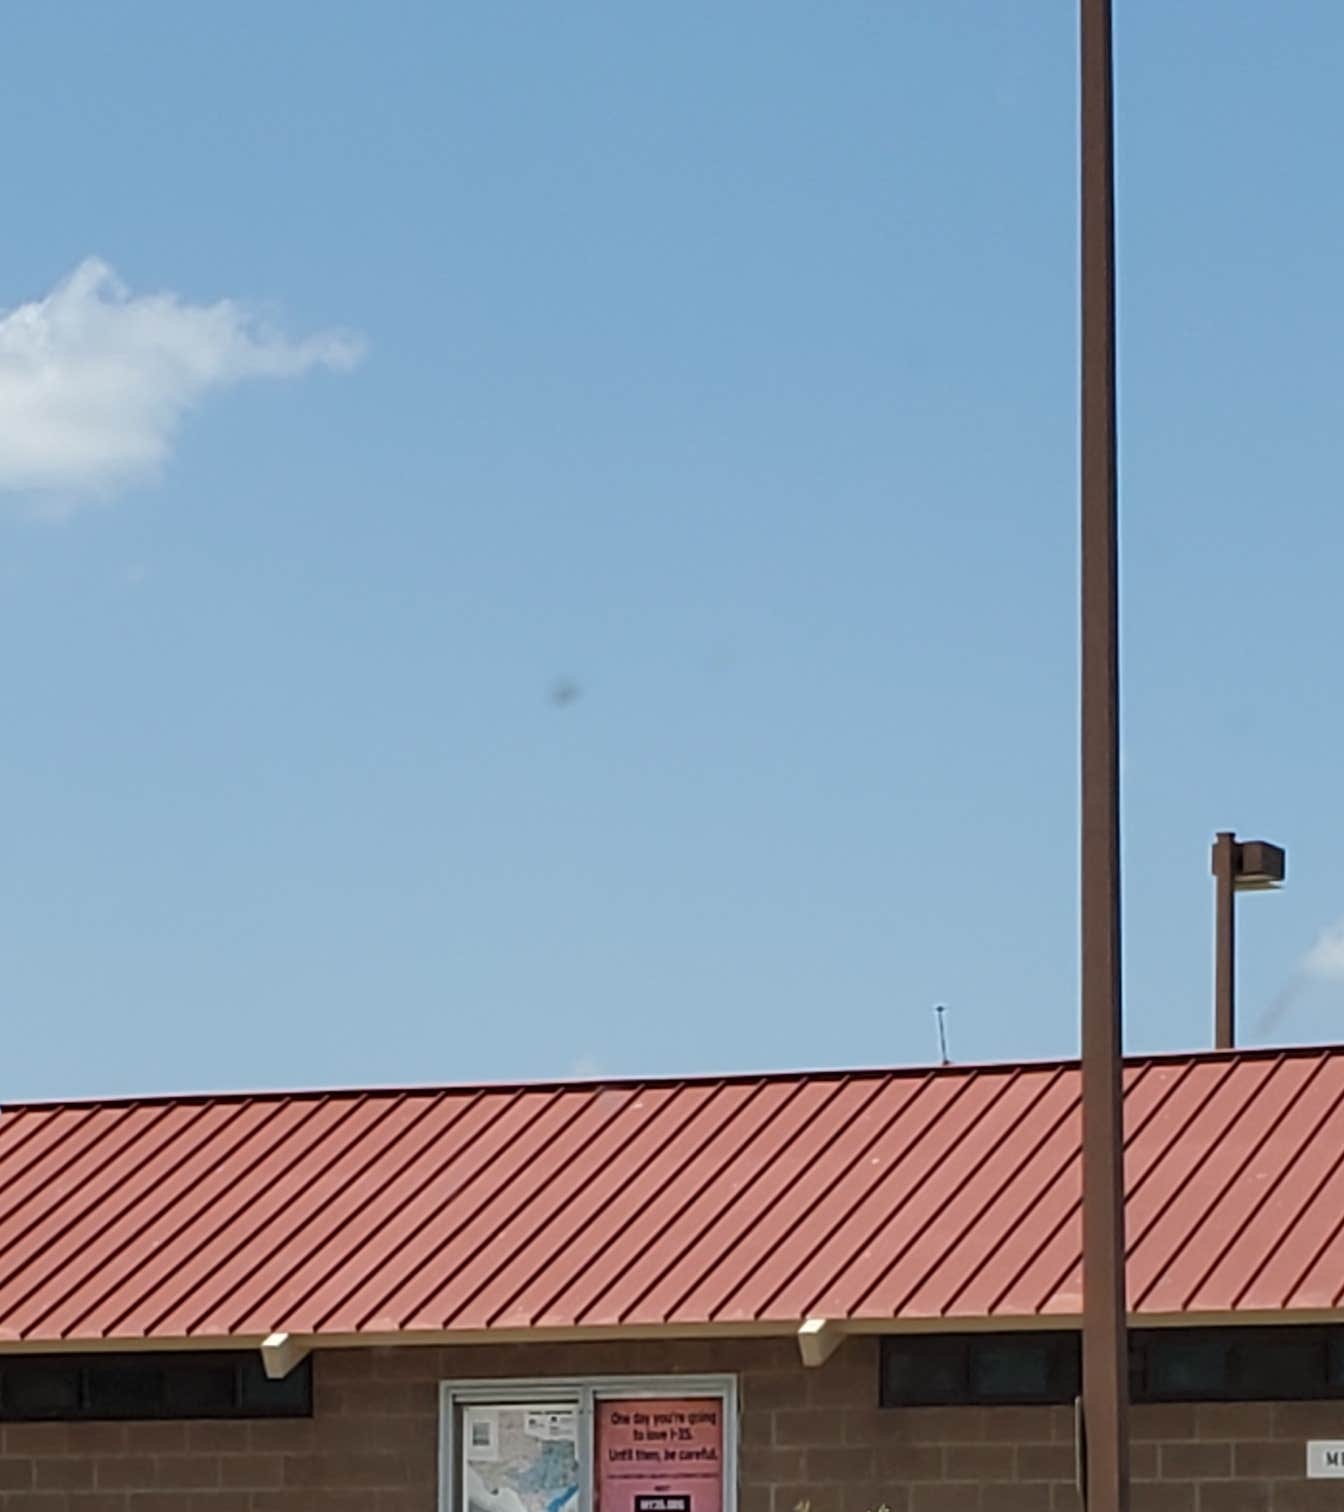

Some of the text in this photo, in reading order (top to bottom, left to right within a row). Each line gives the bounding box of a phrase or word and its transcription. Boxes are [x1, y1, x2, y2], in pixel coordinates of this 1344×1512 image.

[610, 1411, 630, 1425] One
[633, 1411, 650, 1426] day
[688, 1412, 716, 1427] going
[608, 1448, 633, 1461] Until
[664, 1448, 676, 1460] be
